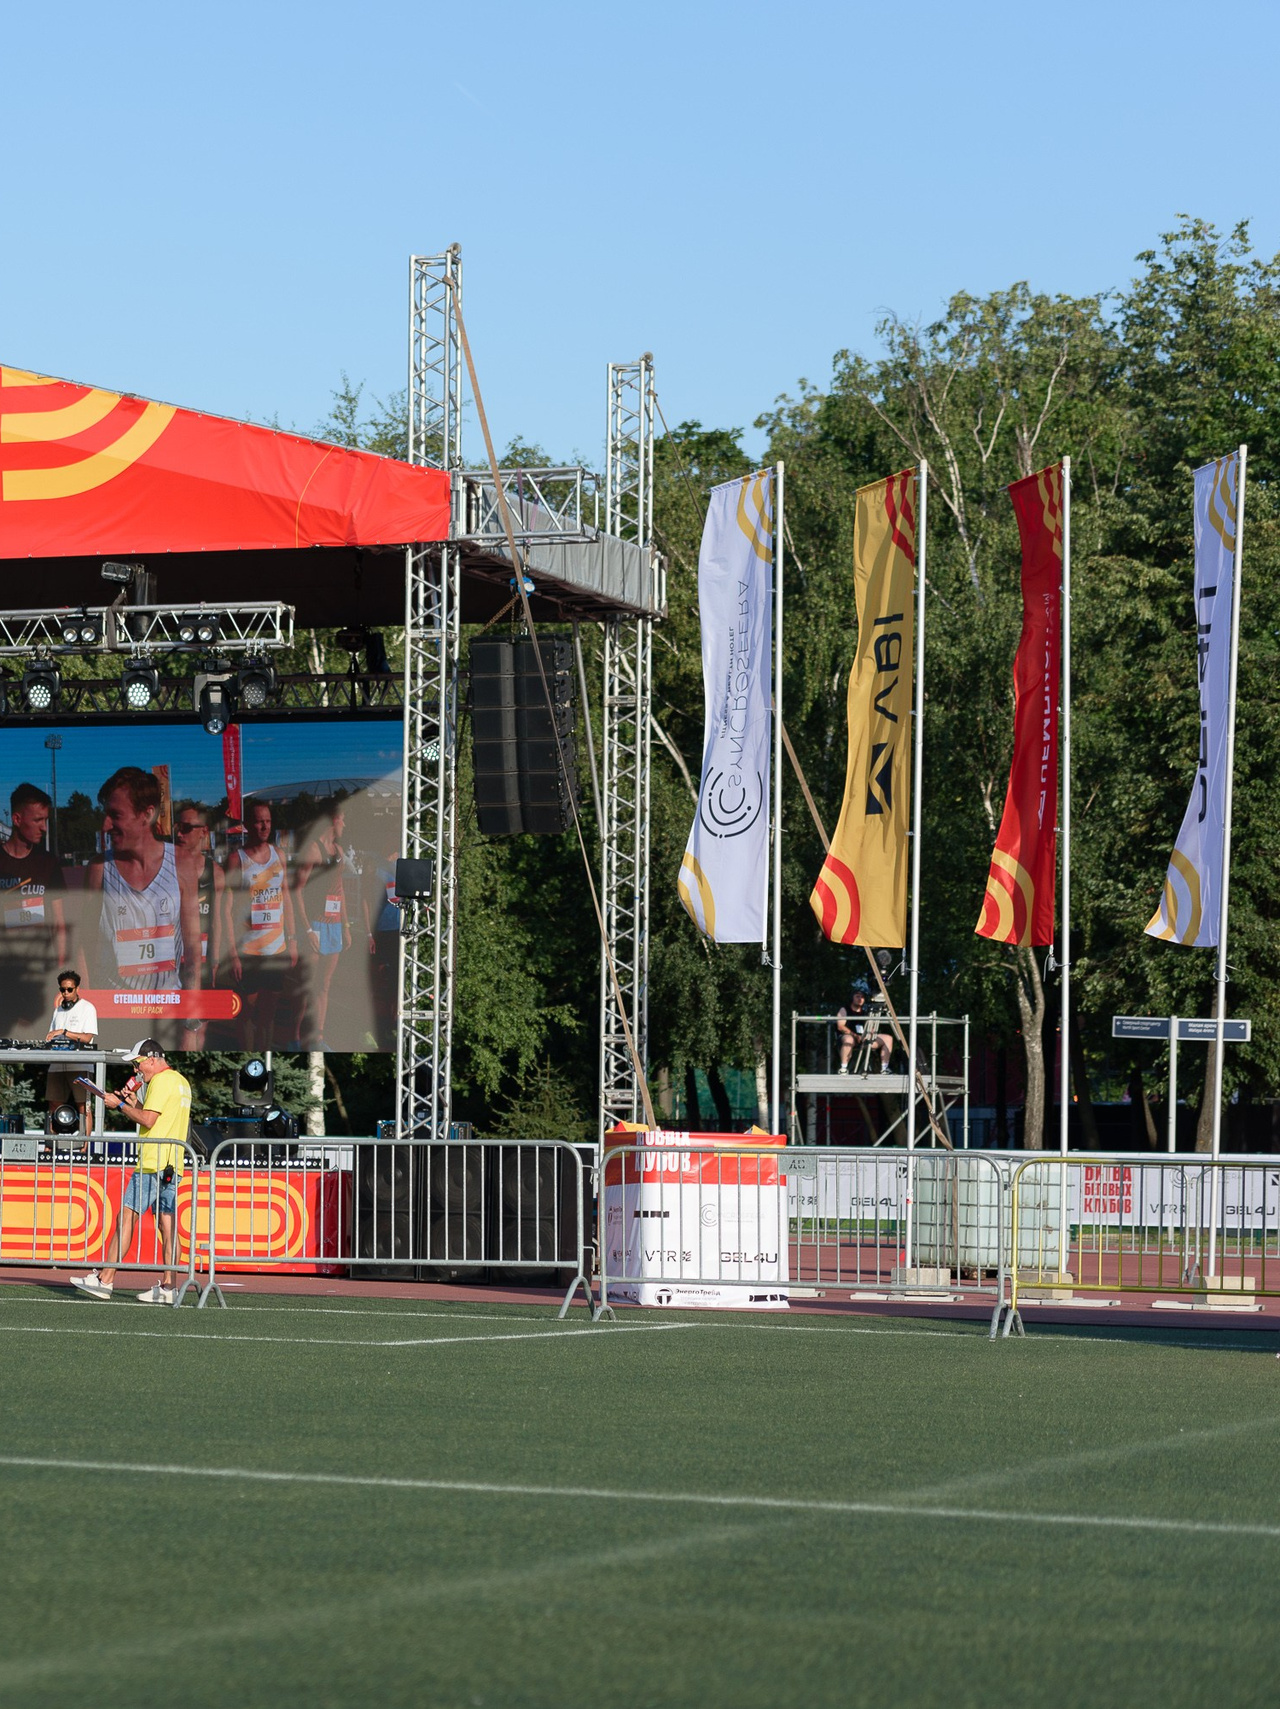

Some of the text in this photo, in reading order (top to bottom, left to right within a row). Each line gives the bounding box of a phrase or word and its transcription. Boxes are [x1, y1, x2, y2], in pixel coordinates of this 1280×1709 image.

[0, 878, 22, 889] RUN
[20, 885, 45, 895] CLUB
[253, 887, 280, 897] DRAFT
[262, 911, 272, 921] 76
[139, 943, 155, 960] 79
[114, 992, 181, 1004] СТЕПАН КИСЕЛЁВ
[131, 1006, 163, 1015] WOLF PACK
[645, 1250, 677, 1262] VTR
[720, 1251, 779, 1264] GEL4U
